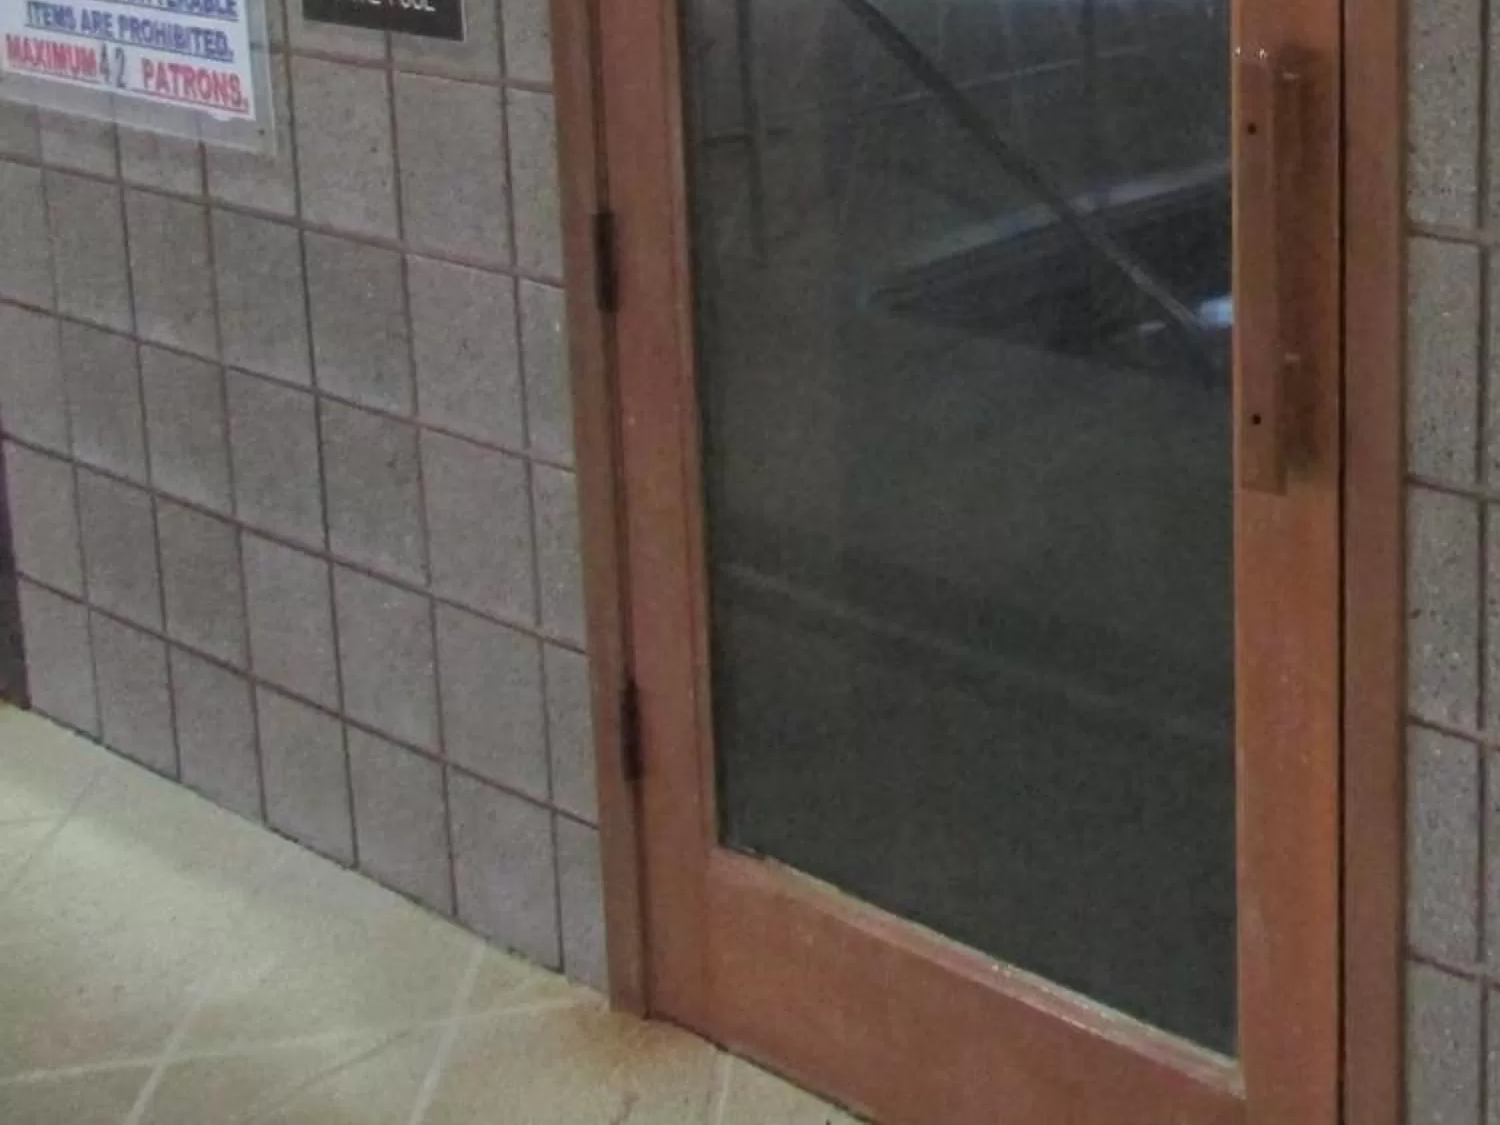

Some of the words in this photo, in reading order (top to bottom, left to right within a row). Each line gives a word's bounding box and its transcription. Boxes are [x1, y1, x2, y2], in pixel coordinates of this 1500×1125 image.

[26, 0, 77, 31] ITEMS
[81, 7, 113, 39] ARE
[6, 32, 97, 77] MAXIMUM
[99, 43, 127, 89] 42
